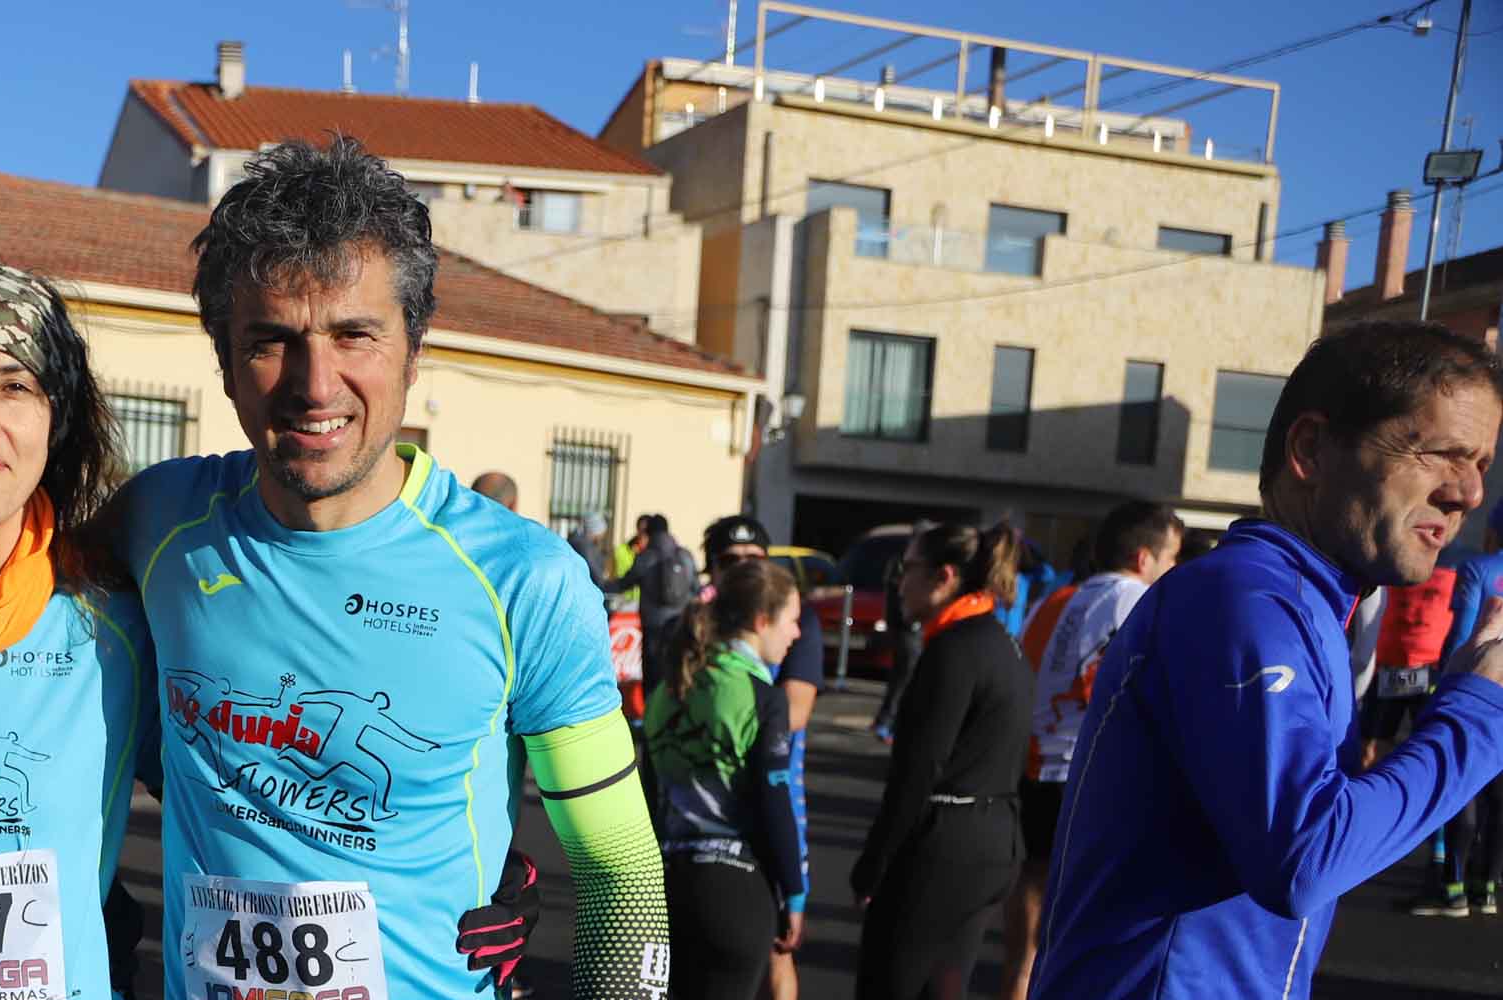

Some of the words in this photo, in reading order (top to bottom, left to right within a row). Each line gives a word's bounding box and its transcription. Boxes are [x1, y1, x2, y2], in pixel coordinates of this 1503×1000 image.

[365, 598, 440, 622] HOSPES
[363, 617, 412, 634] HOTELS
[233, 761, 369, 823] FLOWERS
[243, 890, 278, 916] CROSS
[280, 889, 367, 917] CABRERIZOS
[215, 919, 334, 987] 488
